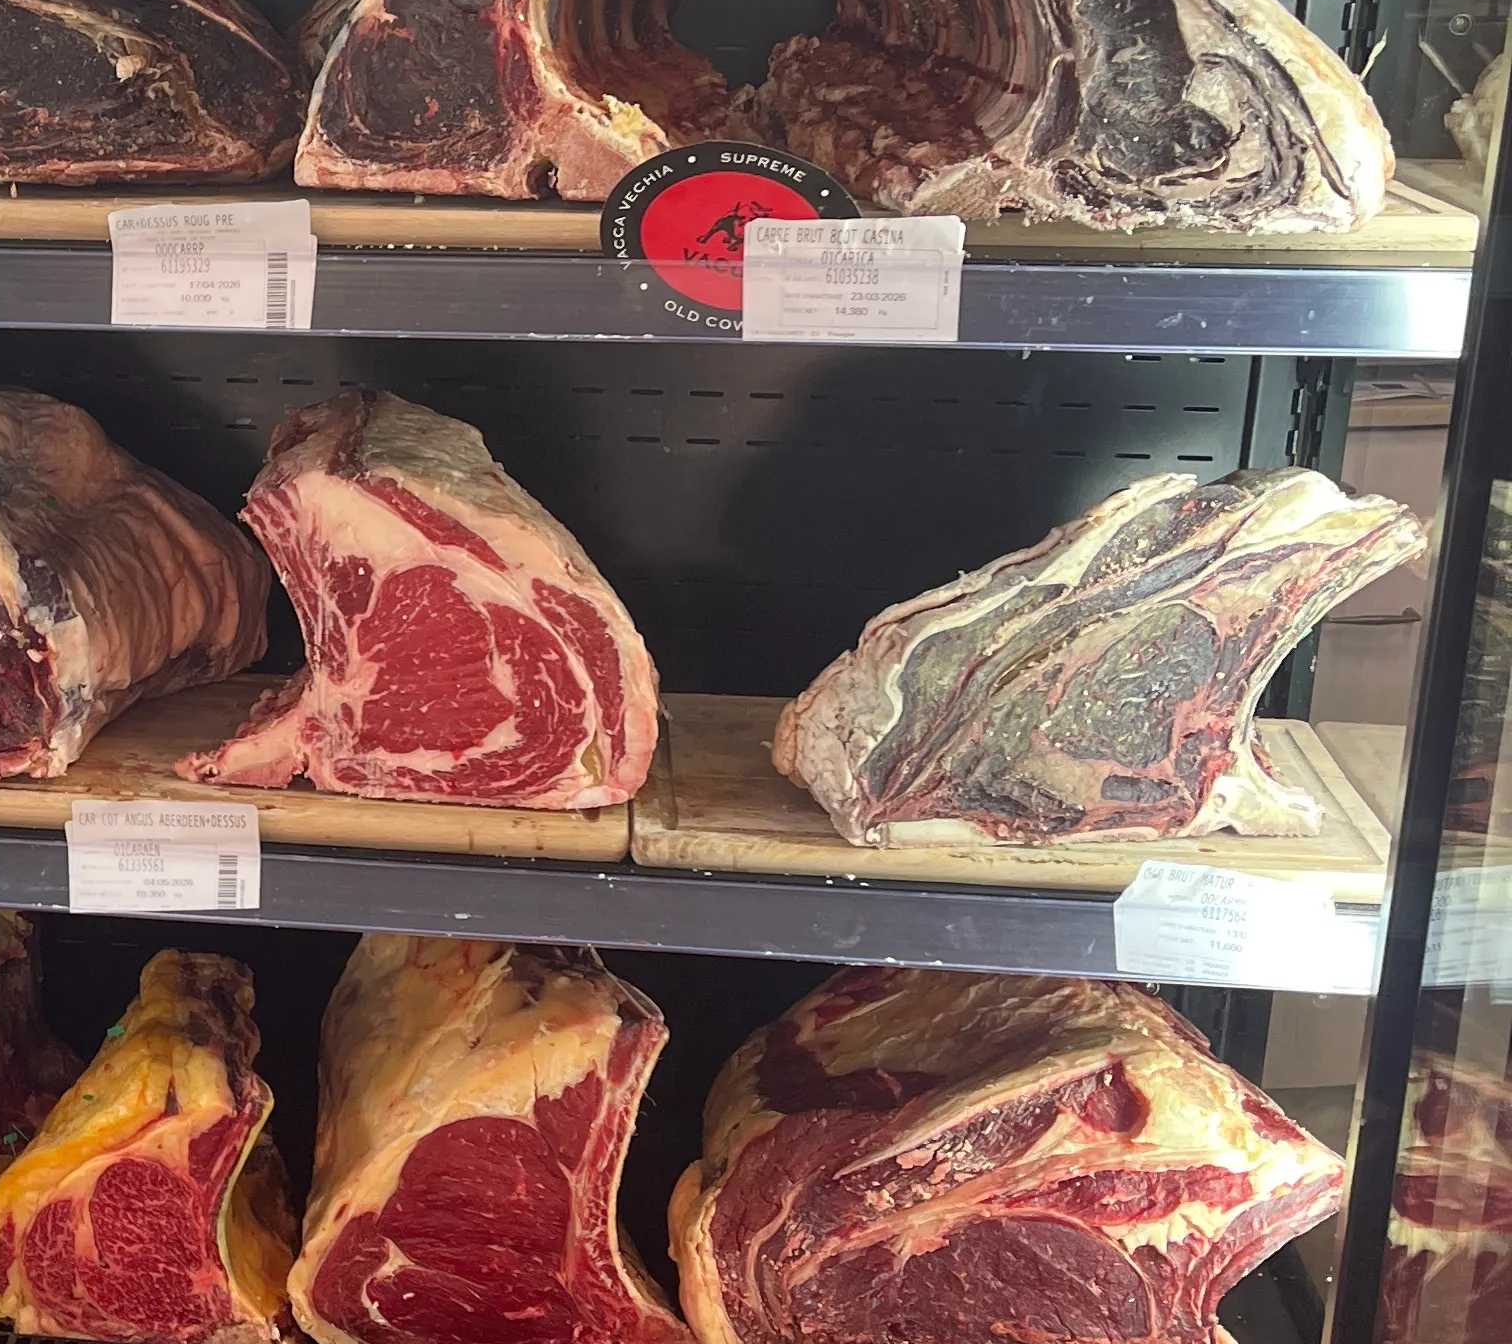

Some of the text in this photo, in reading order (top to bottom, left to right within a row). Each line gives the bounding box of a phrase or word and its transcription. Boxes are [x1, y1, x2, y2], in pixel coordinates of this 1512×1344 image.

[720, 152, 807, 183] SUPREME
[184, 214, 210, 227] ROUG
[215, 213, 234, 226] PRE
[613, 164, 674, 270] VACCA VECHIA
[756, 226, 791, 243] CARRE
[796, 227, 824, 243] BRUT
[863, 229, 904, 245] CASINA
[160, 257, 211, 274] 61195329
[825, 268, 879, 285] 61035238
[664, 300, 700, 322] OLD
[78, 812, 96, 826] CAR
[101, 812, 119, 826] COT
[124, 812, 154, 827] ANGUS
[118, 858, 165, 873] 61335561
[1168, 868, 1196, 883] BRUT
[1200, 871, 1235, 890] MATUR
